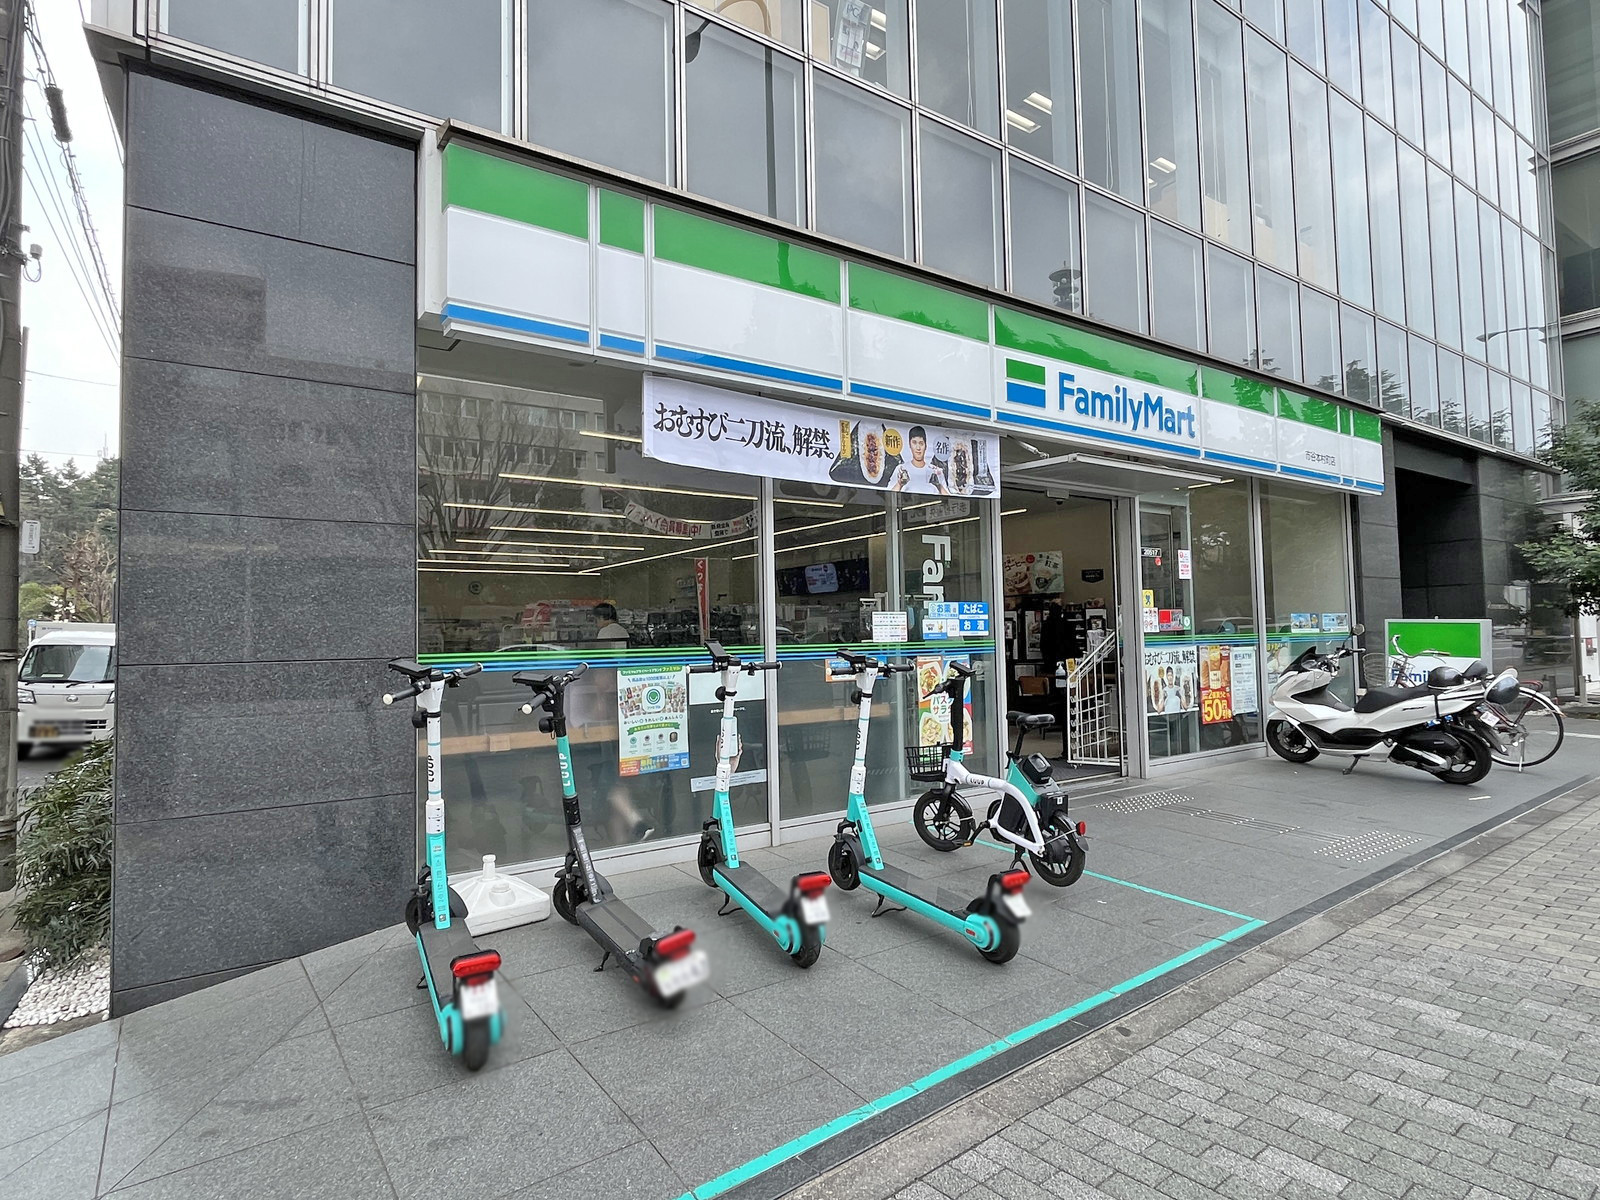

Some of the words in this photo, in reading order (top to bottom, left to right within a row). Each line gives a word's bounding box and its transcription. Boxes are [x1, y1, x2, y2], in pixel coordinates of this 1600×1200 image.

[1058, 371, 1196, 439] FamilyMart
[653, 402, 835, 460] おむすび二刀流、解禁。
[885, 434, 901, 449] 新作
[936, 441, 950, 455] 名作
[963, 603, 984, 614] たばこ
[963, 620, 985, 631] お酒
[559, 752, 571, 787] LUUP
